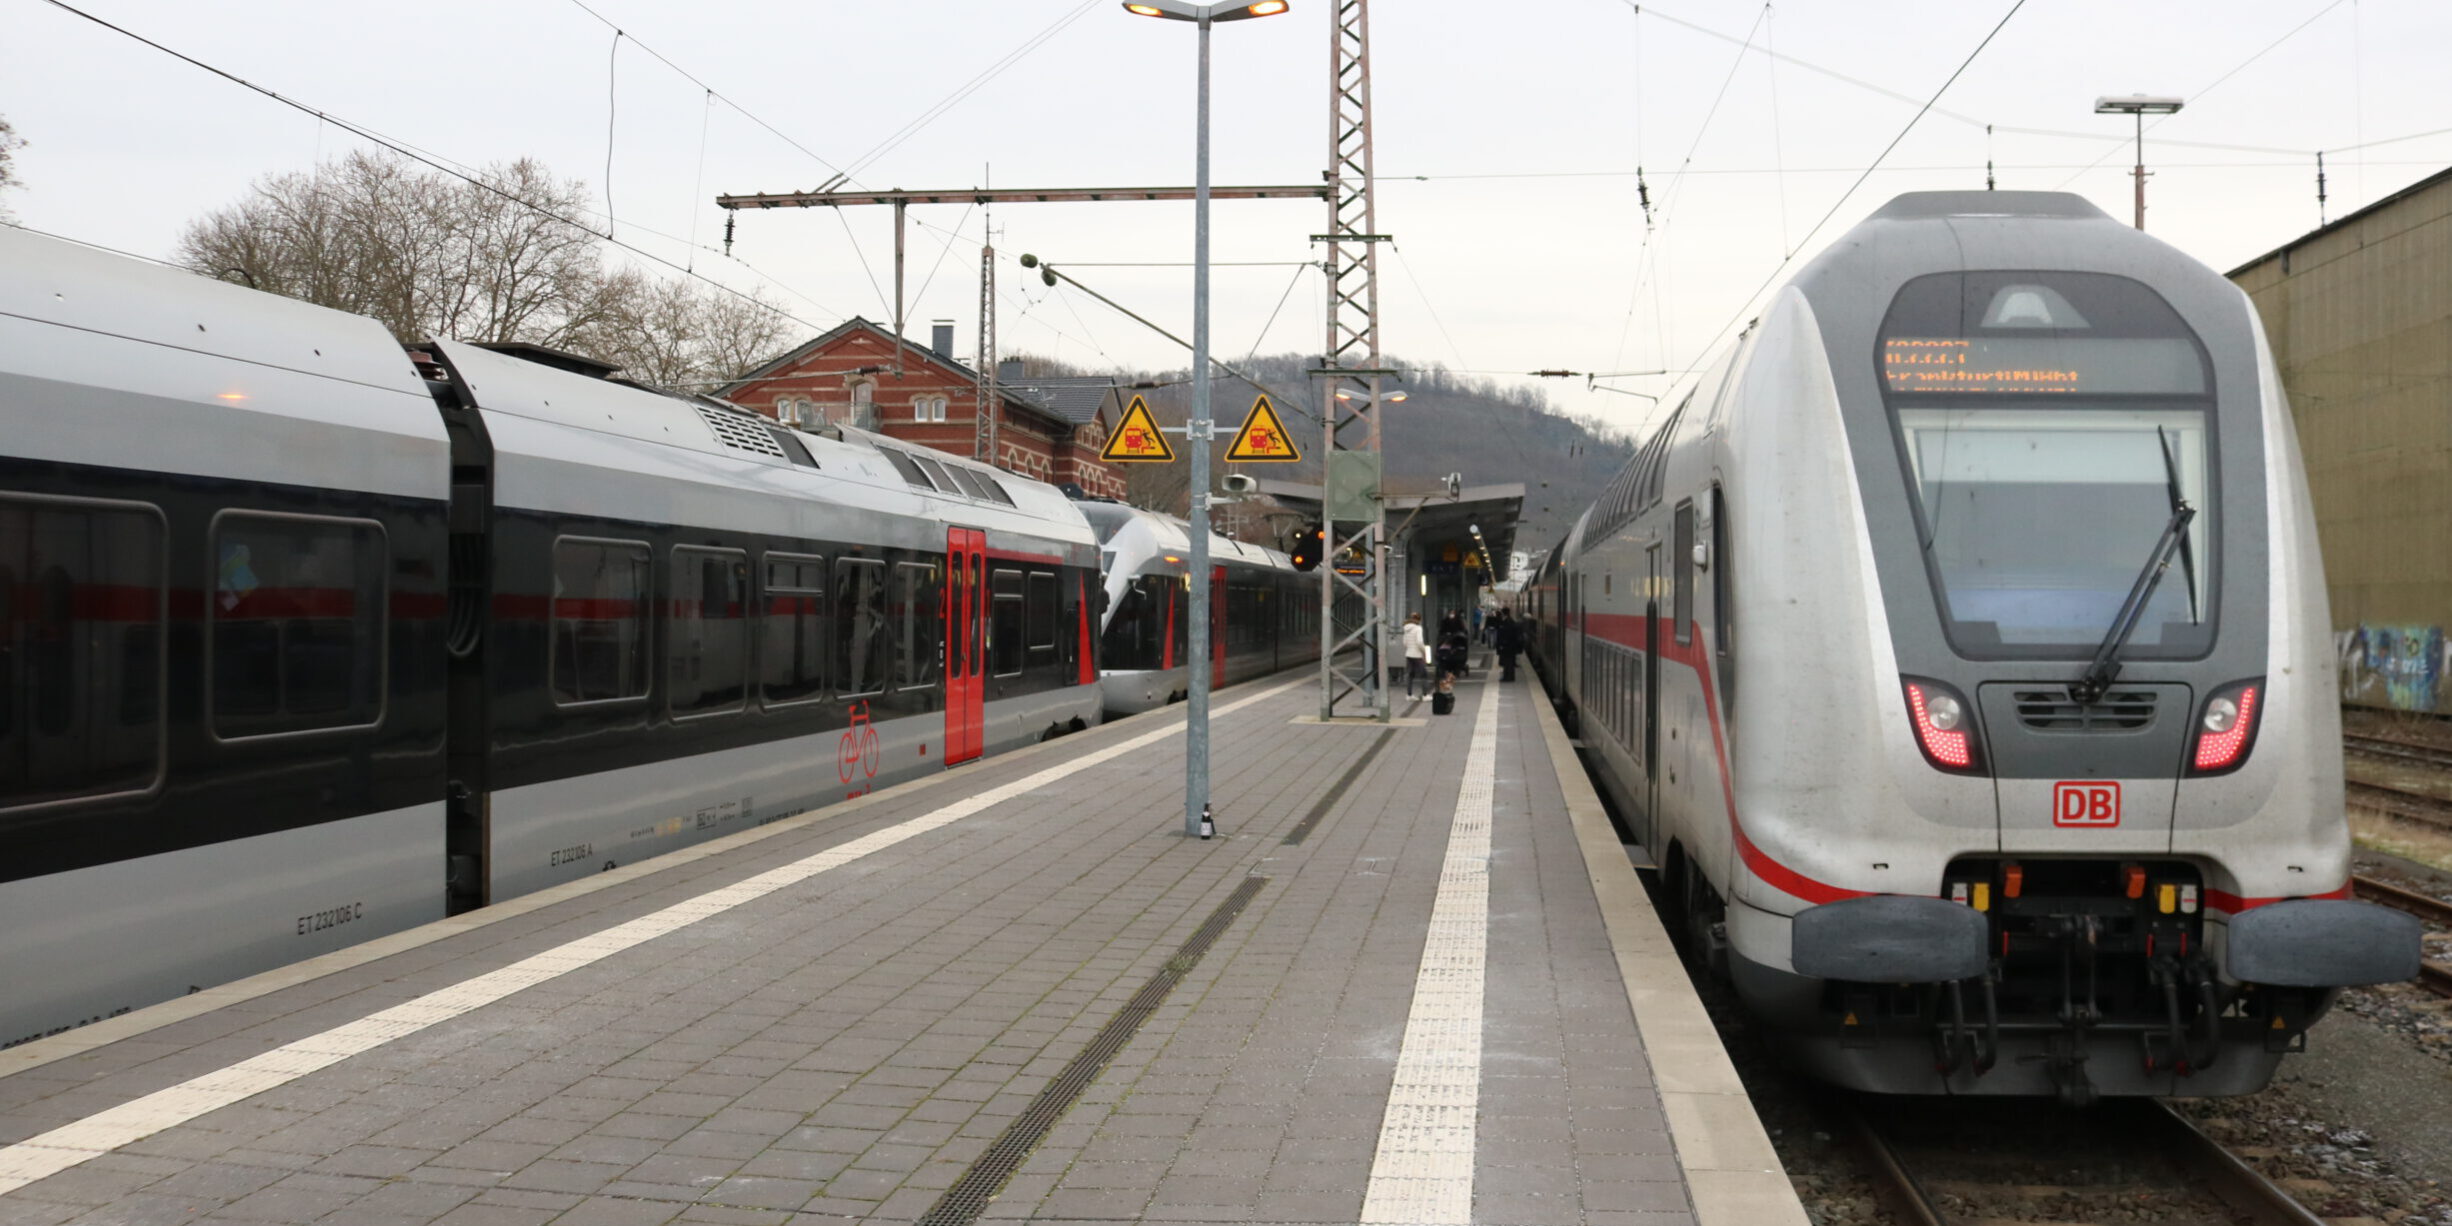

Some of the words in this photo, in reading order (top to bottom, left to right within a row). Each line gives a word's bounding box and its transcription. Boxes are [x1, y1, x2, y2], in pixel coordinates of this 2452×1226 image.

[2061, 788, 2113, 821] DB
[551, 850, 560, 867] ET
[298, 915, 313, 935] ET
[315, 904, 352, 932] 232106
[354, 901, 362, 920] C
